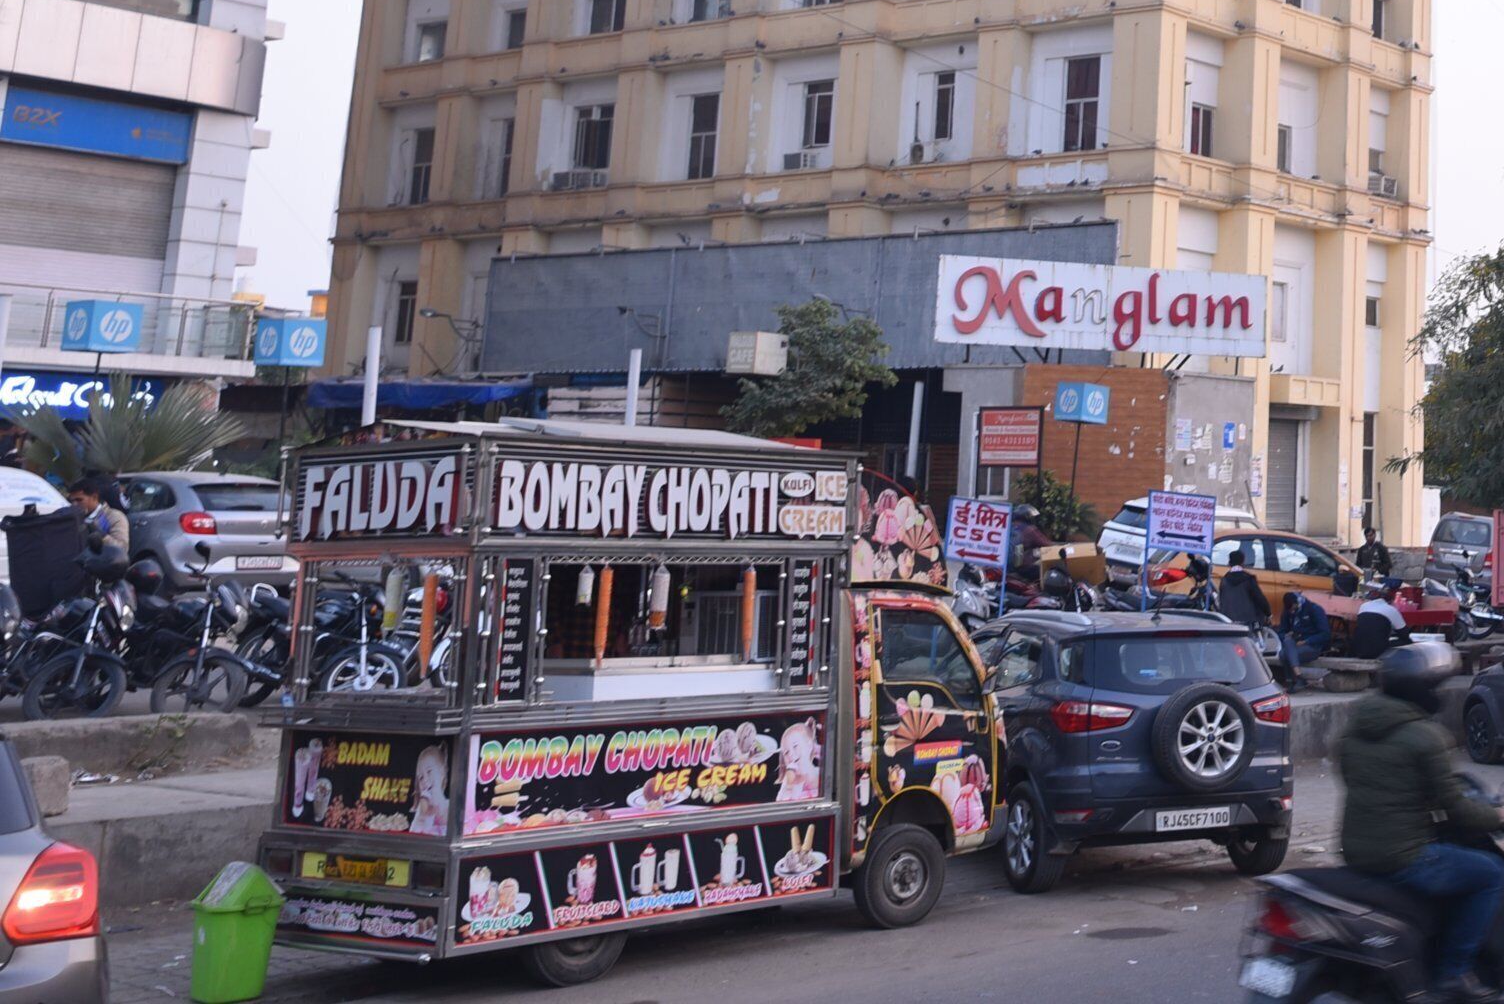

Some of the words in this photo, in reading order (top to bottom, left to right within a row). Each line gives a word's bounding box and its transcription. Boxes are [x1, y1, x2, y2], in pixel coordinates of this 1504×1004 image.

[13, 105, 63, 126] B2X
[952, 266, 1253, 351] Manglam
[70, 309, 87, 340] hp
[101, 309, 132, 343] hp
[260, 326, 277, 357] hp
[291, 326, 318, 357] hp
[1061, 389, 1077, 412] hp
[1088, 391, 1104, 415] hp
[783, 479, 812, 491] KULFI
[818, 475, 846, 498] ICE
[301, 456, 456, 541] FALUDA
[499, 460, 647, 538] BOMBAY
[650, 468, 778, 540] CHOPATI
[781, 509, 844, 533] CREAM
[953, 526, 1002, 545] CSC
[337, 741, 391, 766] BADAM
[477, 734, 605, 785] BOMBAY
[604, 725, 718, 774] CHOPATI
[361, 776, 411, 803] SHAKE
[654, 768, 692, 793] ICE
[696, 763, 768, 788] CREAM
[1163, 811, 1228, 828] RJ45CF7100
[470, 911, 534, 935] FALUDA
